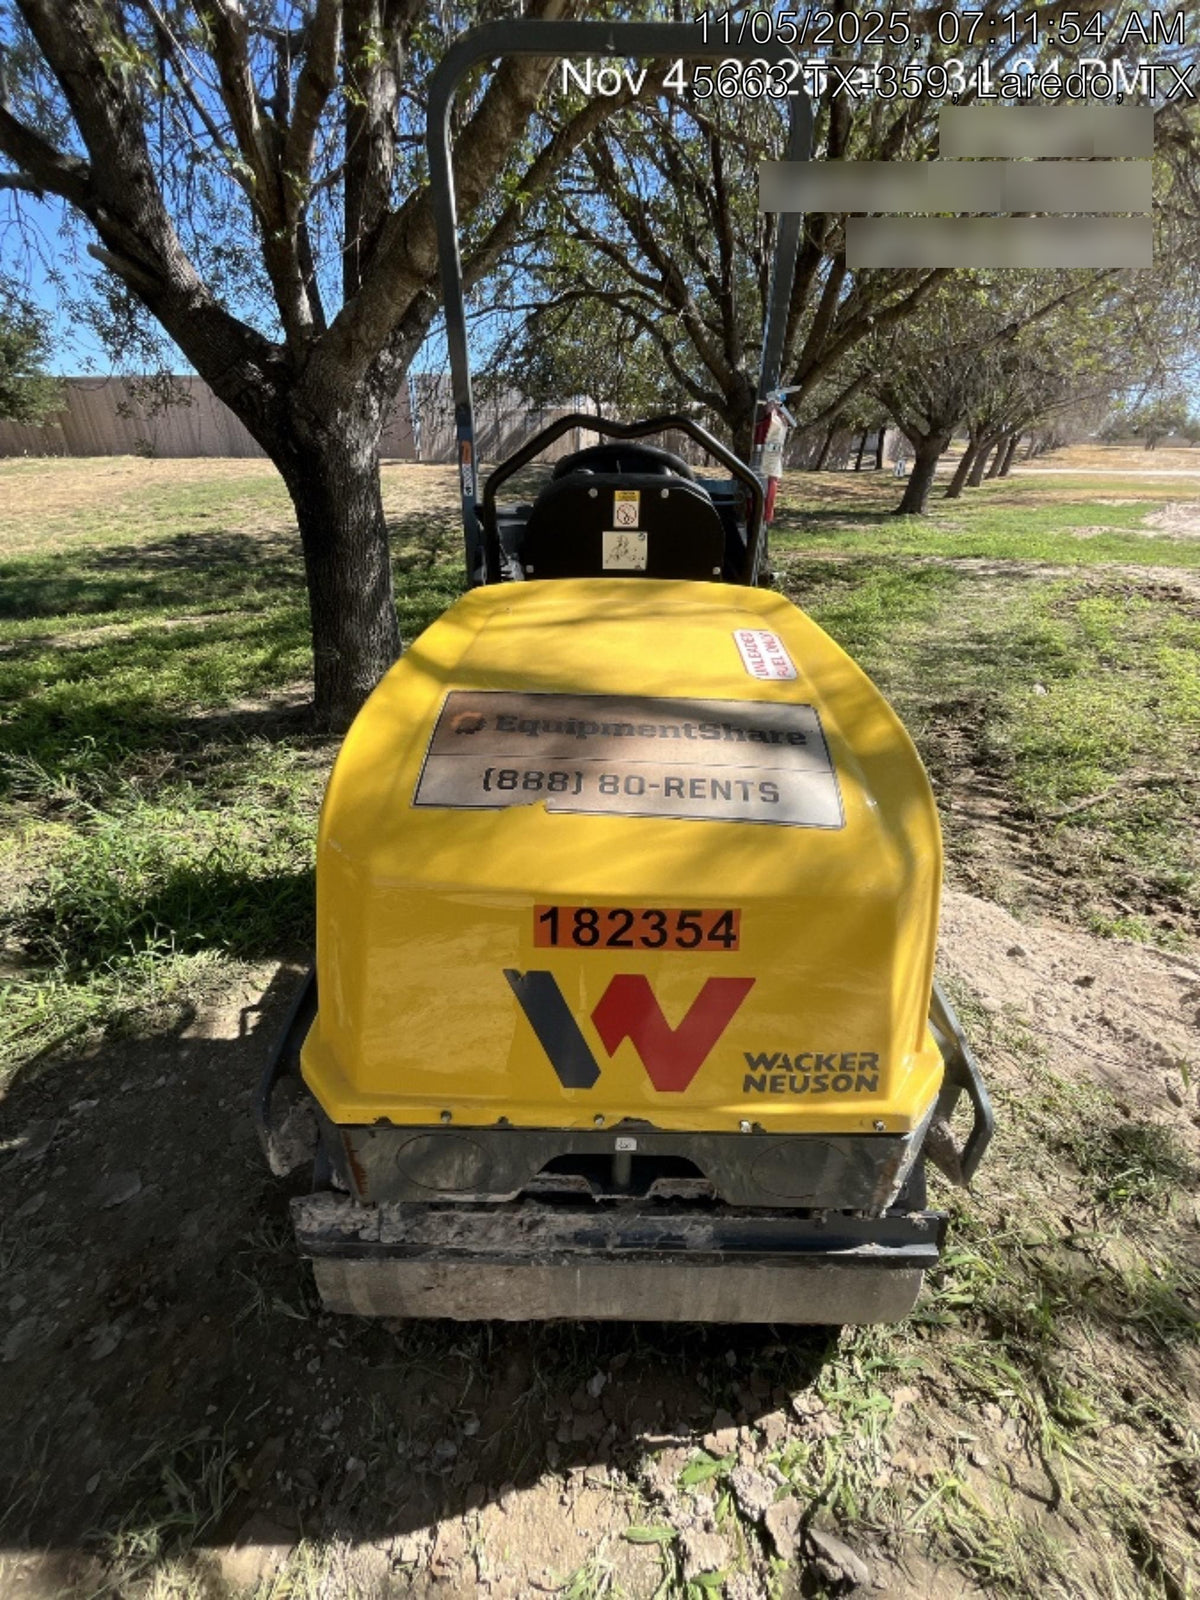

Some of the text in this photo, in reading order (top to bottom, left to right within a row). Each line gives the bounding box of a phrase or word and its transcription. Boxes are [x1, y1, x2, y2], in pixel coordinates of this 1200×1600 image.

[740, 632, 769, 676] UNLEADED
[771, 655, 792, 678] FUEL
[496, 714, 807, 746] EquipmentShare
[482, 767, 780, 804] (888) 80-RENTS
[539, 906, 738, 949] 182354
[743, 1051, 880, 1072] WACKER
[742, 1073, 880, 1094] NEUSON
